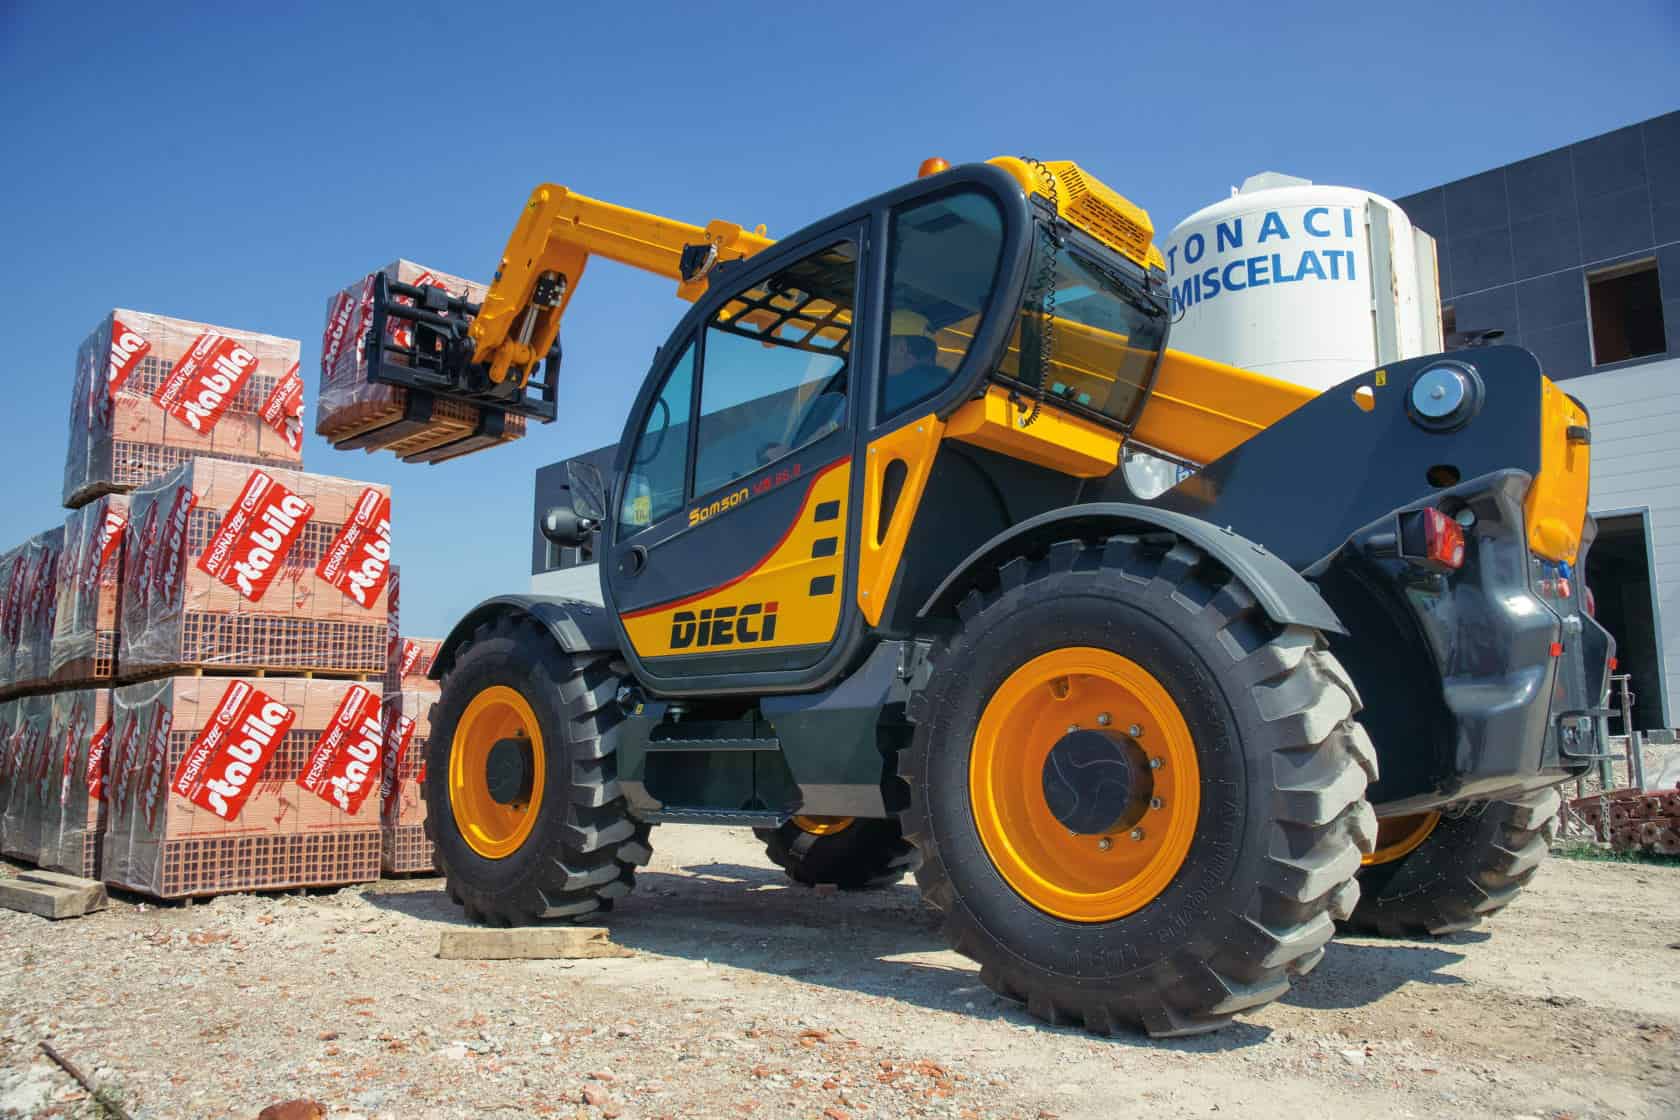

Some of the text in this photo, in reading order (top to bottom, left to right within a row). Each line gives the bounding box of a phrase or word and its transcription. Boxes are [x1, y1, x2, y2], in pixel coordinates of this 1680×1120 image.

[1168, 207, 1353, 276] TONACI
[1171, 250, 1356, 315] MISCELATI
[184, 346, 254, 430] stabila
[688, 487, 749, 527] Samson
[234, 495, 307, 596] stabila
[669, 601, 779, 649] DIECI
[206, 702, 290, 816] stabila
